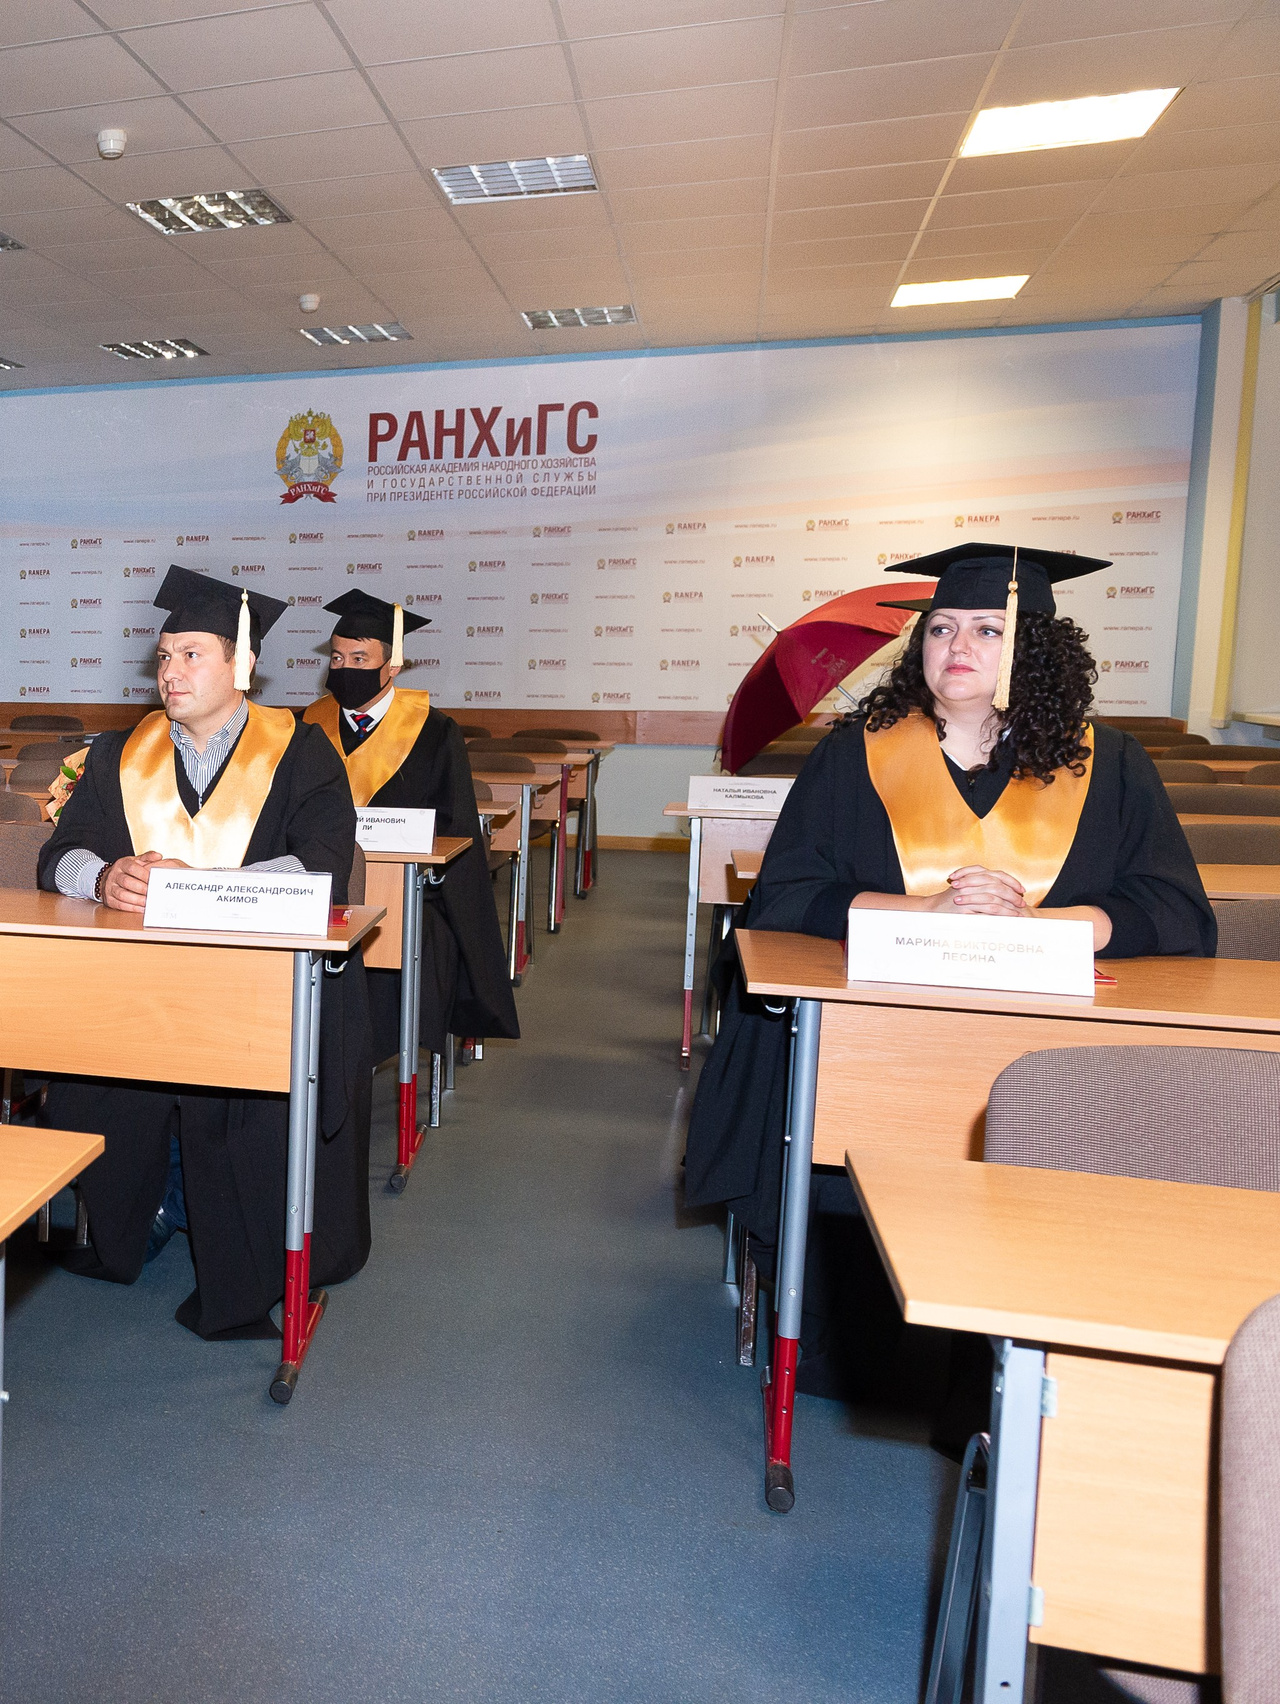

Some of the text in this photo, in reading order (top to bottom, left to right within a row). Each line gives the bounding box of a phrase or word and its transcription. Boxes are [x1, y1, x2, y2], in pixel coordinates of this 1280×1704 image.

[368, 400, 599, 462] РАНХиГС
[367, 456, 597, 476] РОССИЙСКАЯ АКАДЕМИЯ НАРОДНОГО ХОЗЯЙСТВА
[367, 470, 597, 489] И ГОСУДАРСТВЕННОЙ СЛУЖБЫ
[290, 483, 328, 496] РАНХиГС
[366, 484, 596, 502] ПРИ ПРЕЗИДЕНТЕ РОССИЙСКОЙ ФЕДЕРАЦИИ
[1126, 510, 1162, 519] РАНХиГС
[818, 518, 849, 527] РАНХиГС
[967, 515, 1000, 523] RANEPA
[543, 526, 572, 534] РАНХиГС
[677, 522, 707, 530] RANEPA
[298, 532, 324, 540] РАНХиГС
[417, 529, 444, 537] RANEPA
[745, 555, 775, 563] RANEPA
[478, 560, 506, 568] RANEPA
[1120, 586, 1155, 594] РАНХиГС
[416, 594, 443, 602] RANEPA
[674, 591, 704, 599] RANEPA
[132, 627, 155, 635] РАНХиГС
[605, 625, 634, 633] РАНХиГС
[741, 624, 772, 632] RANEPA
[296, 658, 321, 666] РАНХиГС
[671, 659, 700, 667] RANEPA
[1114, 660, 1149, 668] РАНХиГС
[603, 692, 631, 700] РАНХиГС
[165, 882, 314, 896] АЛЕКСАНДР АЛЕКСАНДРОВИЧ
[216, 895, 258, 904] АКИМОВ
[895, 936, 1044, 955] МАРИНА ВИКТОРОВНА
[942, 952, 996, 964] ЛЕСИНА
